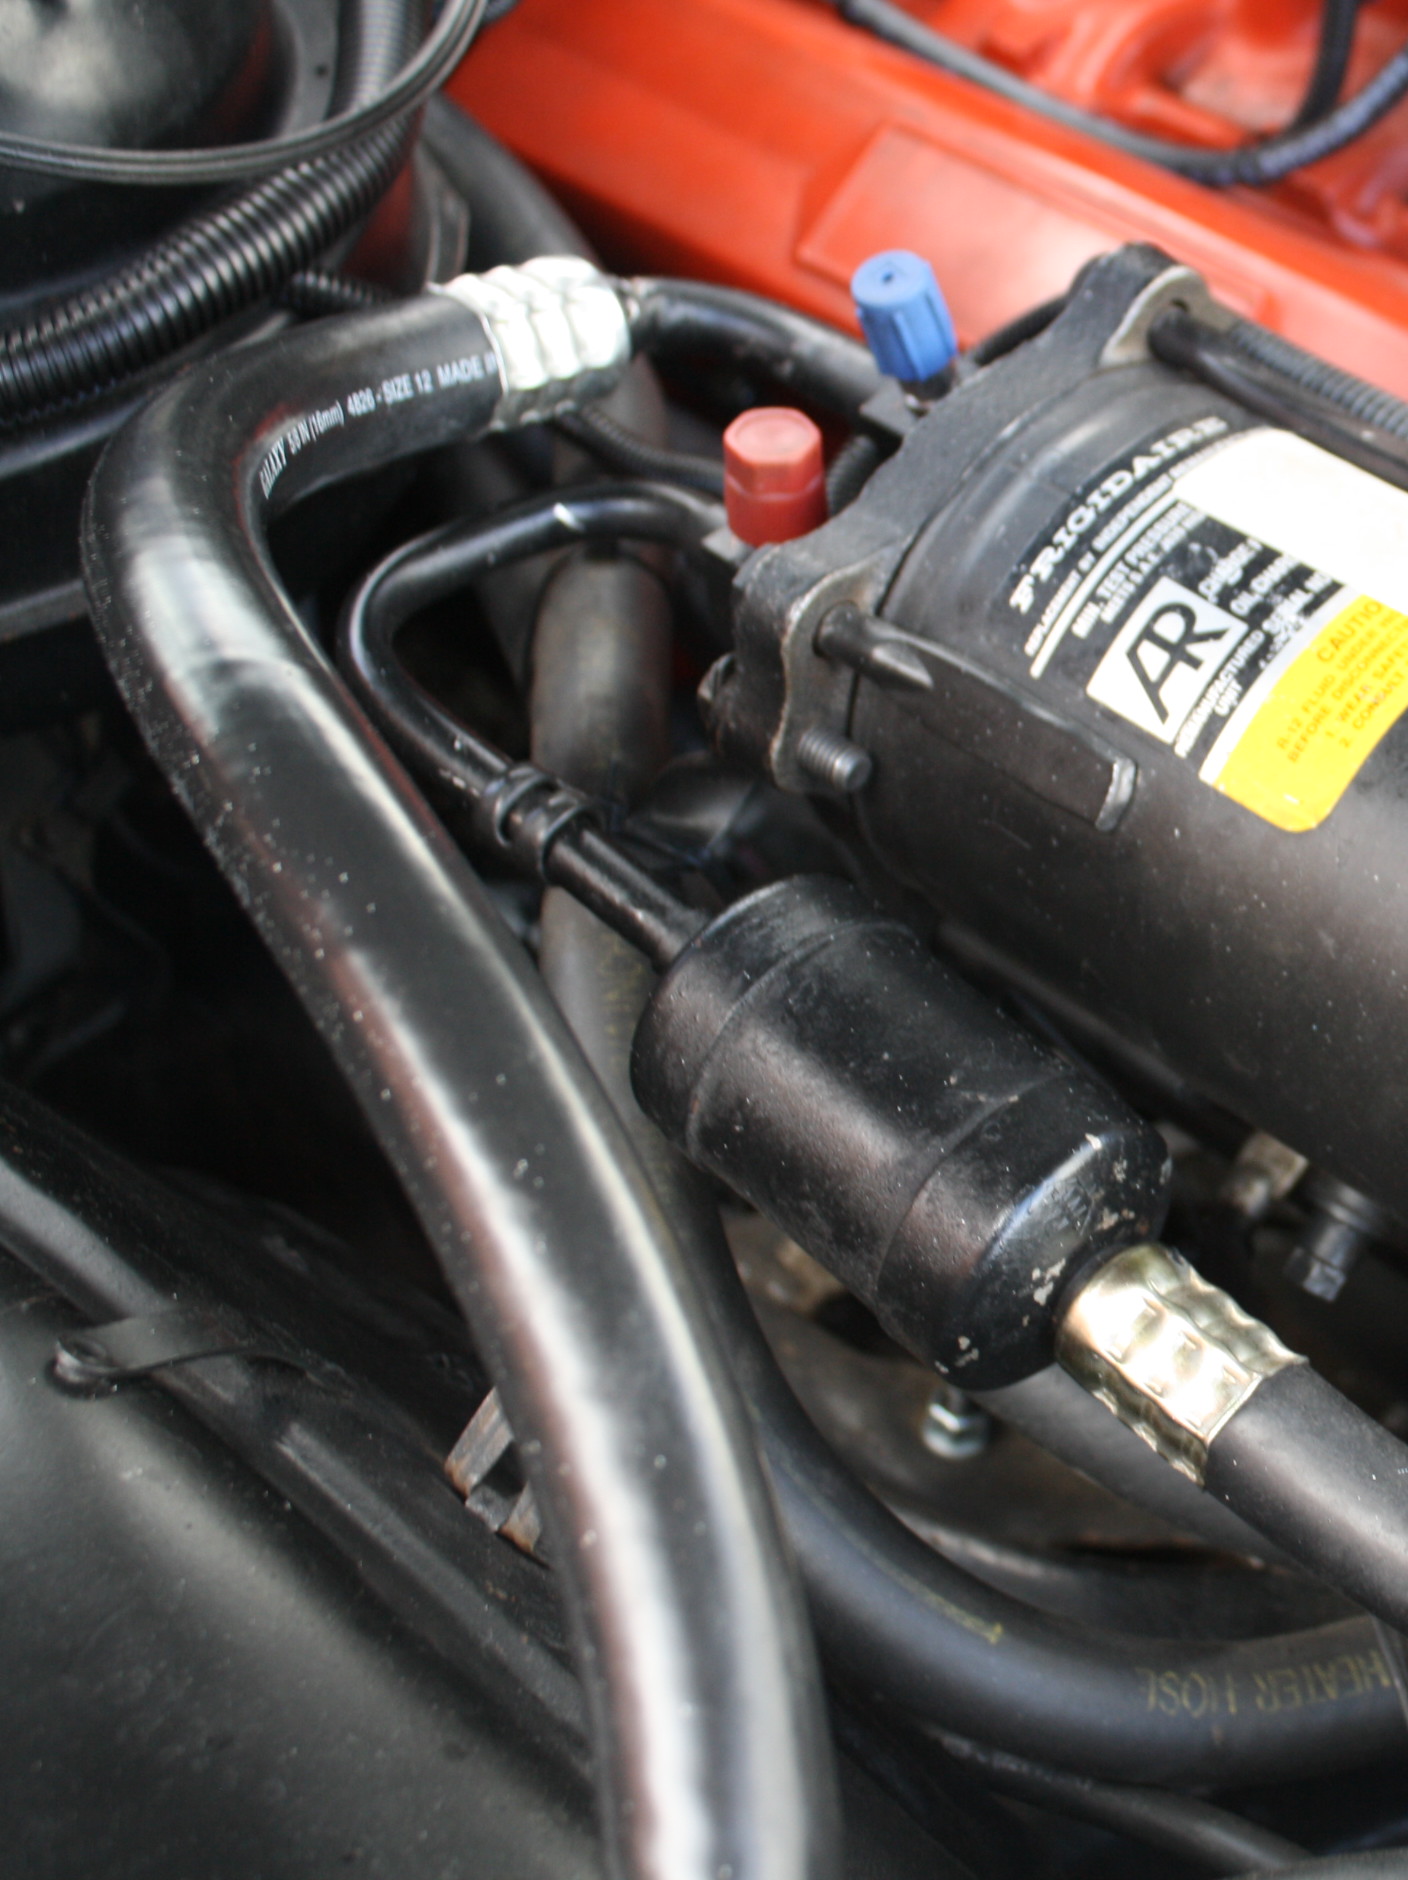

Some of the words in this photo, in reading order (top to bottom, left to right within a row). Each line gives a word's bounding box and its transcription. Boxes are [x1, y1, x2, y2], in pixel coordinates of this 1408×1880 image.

[381, 373, 414, 404] SIZE
[414, 369, 434, 394] 12
[436, 354, 487, 389] MADE
[1008, 415, 1228, 615] FRIGIDAIRE
[1096, 560, 1130, 598] TEST
[1126, 602, 1232, 725] AR
[1301, 674, 1335, 713] FLUID
[1337, 629, 1377, 670] UNDER
[1174, 630, 1266, 758] REMANUFACTURED
[1214, 678, 1243, 717] UNIT
[1337, 685, 1372, 722] WEAR
[1287, 706, 1331, 763] BEFORE
[1253, 1648, 1393, 1712] HEATER
